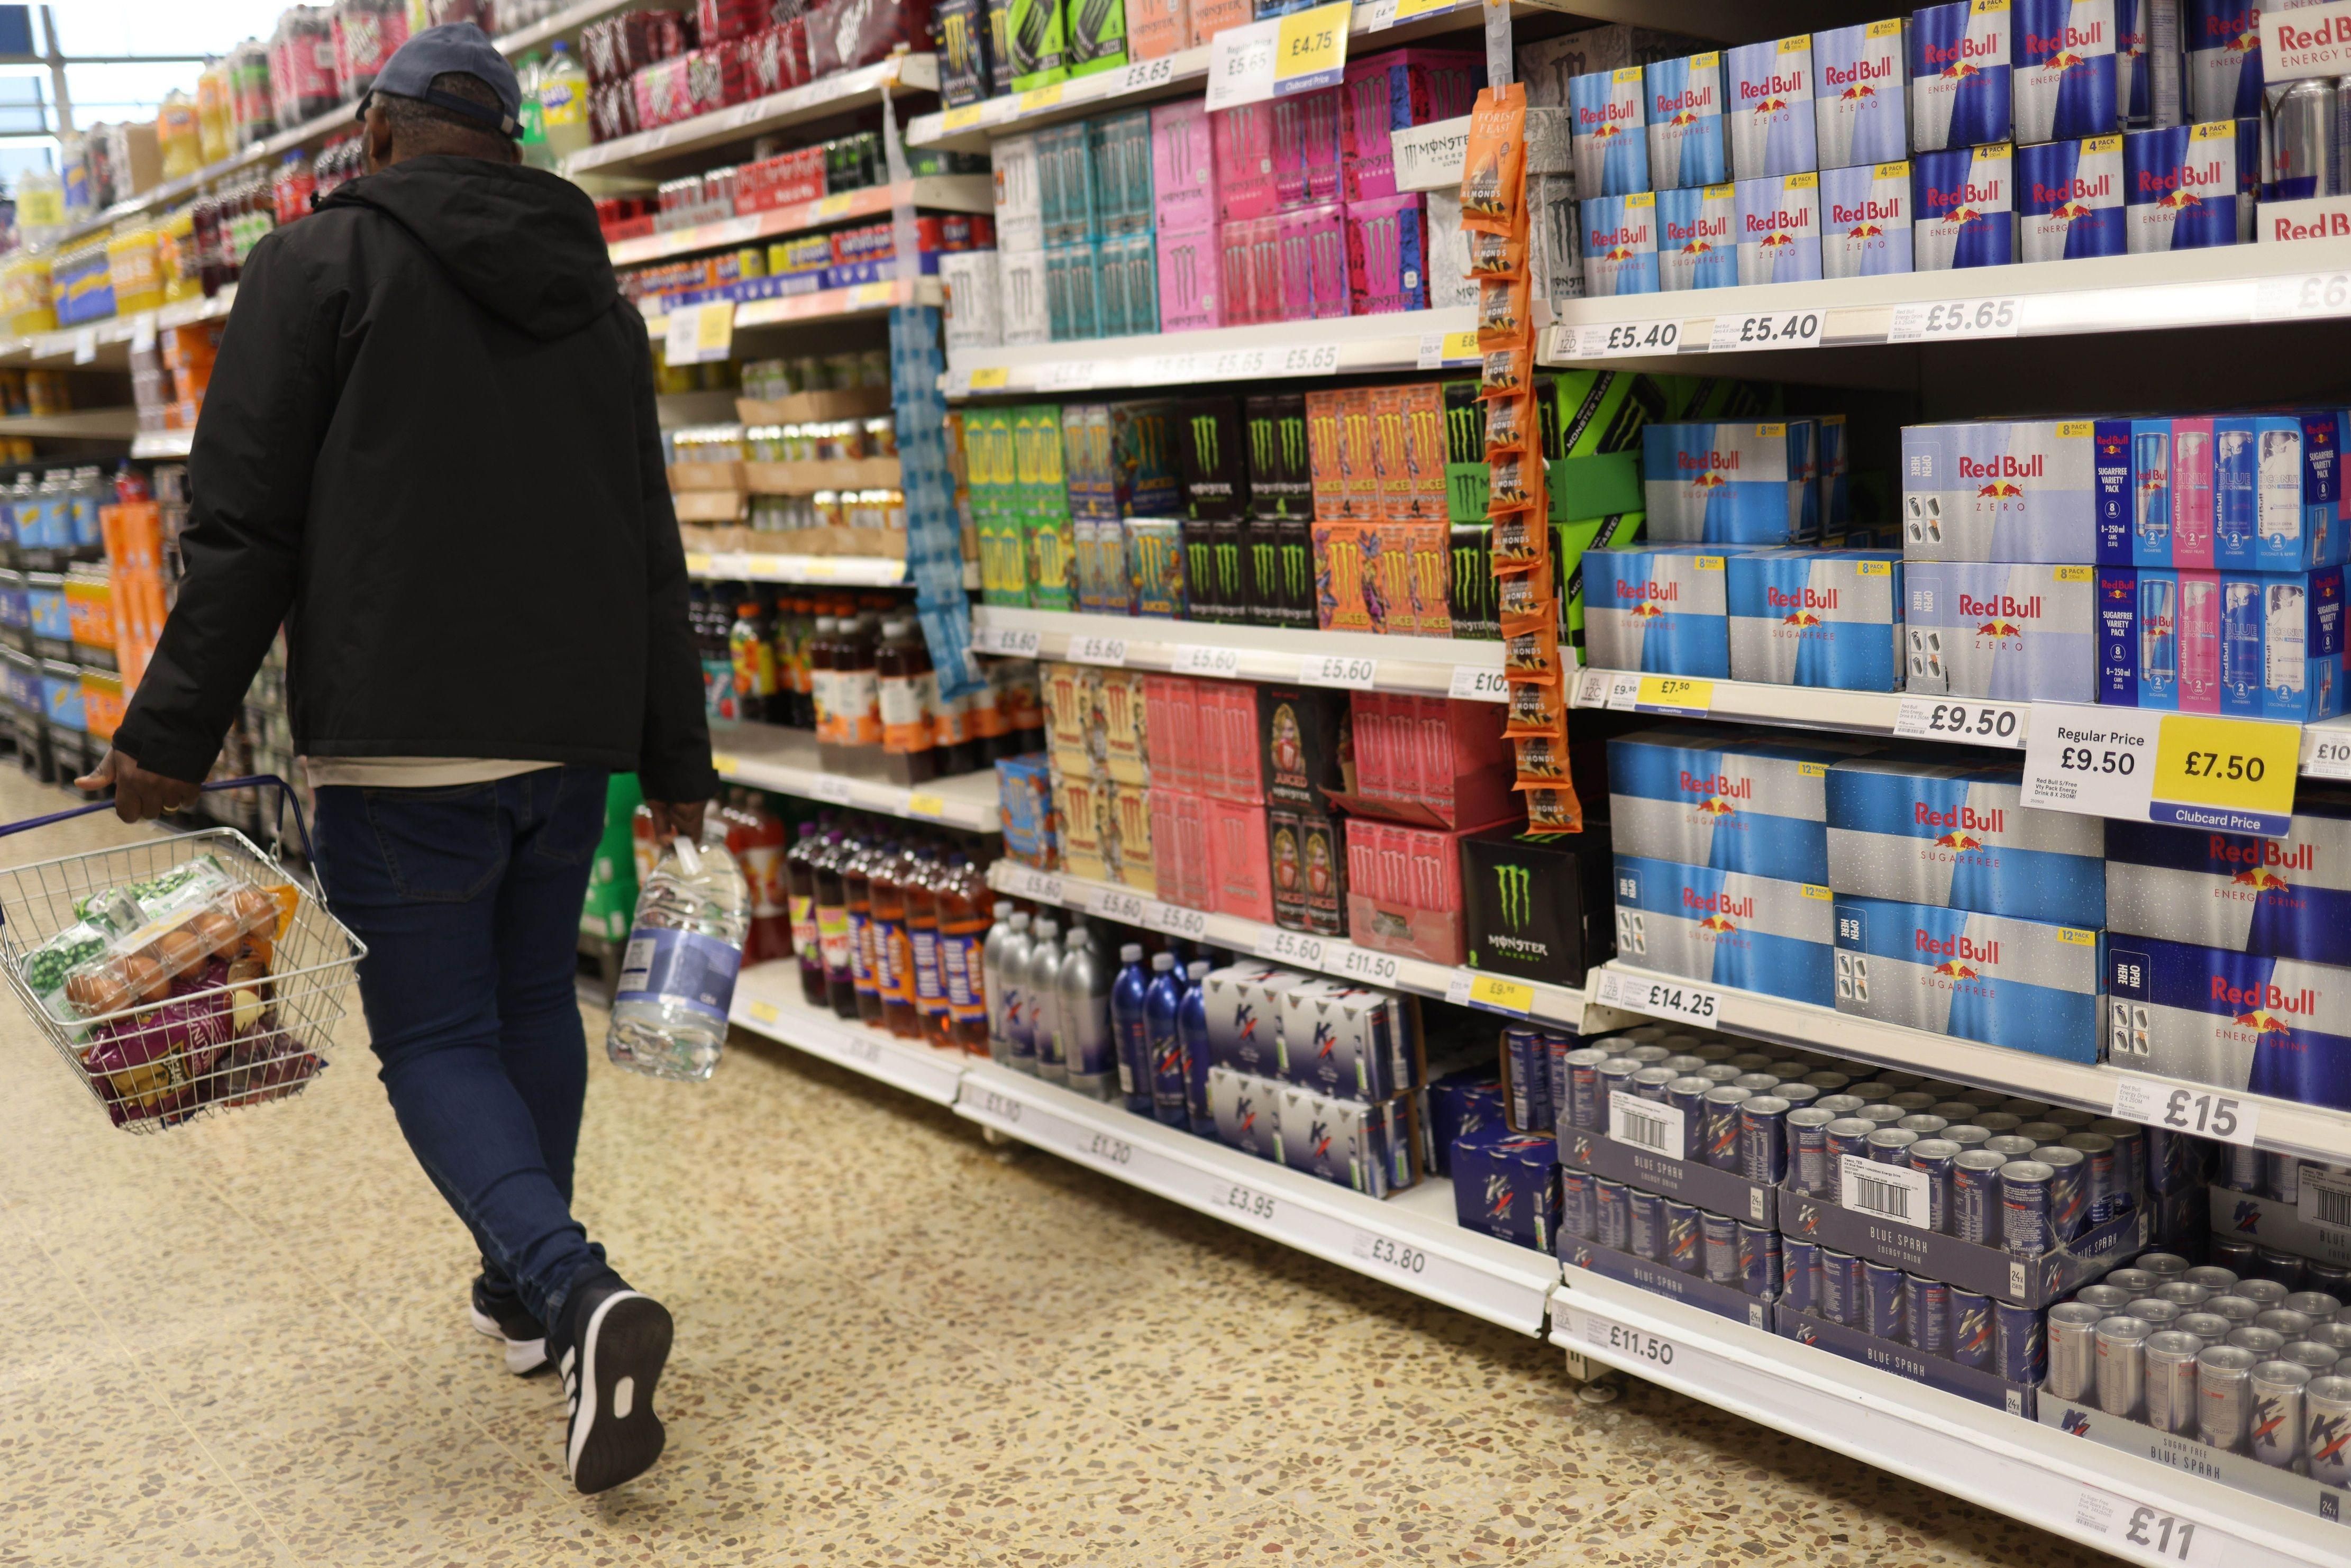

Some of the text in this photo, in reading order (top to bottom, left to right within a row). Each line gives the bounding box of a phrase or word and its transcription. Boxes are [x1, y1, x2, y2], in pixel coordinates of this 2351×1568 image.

[1291, 31, 1332, 56] £4.75
[2026, 21, 2101, 54] Red Bull
[2279, 18, 2331, 51] Red
[1925, 34, 1996, 63] Red Bull
[2282, 50, 2338, 67] ENERGY
[1126, 59, 1171, 87] £5.65
[1826, 57, 1891, 85] Red Bull
[1740, 72, 1801, 99] Red Bull
[1657, 87, 1711, 112] Red Bull
[1839, 101, 1877, 113] ZERO
[1478, 111, 1517, 122] FOREST
[1580, 101, 1634, 125] Red Bull
[1479, 123, 1511, 133] FEAST
[2199, 124, 2226, 138] 4 PACK
[2138, 162, 2220, 191] Red Bull
[1927, 181, 1998, 207] Red Bull
[2032, 175, 2109, 203] Red Bull
[1746, 208, 1808, 231] Red Bull
[1833, 199, 1899, 223] Red Bull
[1592, 225, 1646, 246] Red Bull
[1667, 217, 1726, 239] Red Bull
[2275, 214, 2326, 241] Red
[1846, 240, 1884, 250] ZERO
[1740, 314, 1818, 342] £5.40
[1926, 302, 2014, 331] £5.65
[1608, 324, 1676, 349] £5.40
[1286, 347, 1335, 369] £5.65
[2063, 425, 2070, 436] 8
[2097, 435, 2128, 444] Red Bull
[1678, 451, 1739, 469] Red Bull
[1960, 455, 2042, 478] Red Bull
[2309, 450, 2334, 461] SUGARFREE
[2312, 460, 2331, 469] VARIETY
[2176, 473, 2206, 484] PINK
[2218, 473, 2250, 485] BLUE
[2317, 469, 2328, 478] PACK
[1976, 503, 2025, 512] ZERO
[1495, 535, 1529, 544] ALMONDS
[1617, 580, 1678, 601] Red Bull
[1768, 588, 1837, 609] Red Bull
[1960, 595, 2040, 618] Red Bull
[2103, 612, 2133, 620] SUGARFREE
[1773, 630, 1835, 640] SUGARFREE
[2107, 620, 2128, 628] VARIETY
[2111, 628, 2125, 636] PACK
[1084, 639, 1124, 659] £5.60
[1975, 642, 2022, 651] ZERO
[1192, 649, 1236, 669] £5.60
[1322, 660, 1372, 680] £5.60
[1662, 681, 1689, 694] £7.50
[1929, 705, 2016, 737] £9.50
[2058, 727, 2144, 746] Regular Price
[2061, 747, 2135, 775] £9.50
[2184, 752, 2265, 782] £7.50
[1680, 771, 1751, 798] Red Bull
[1915, 802, 2003, 833] Red Bull
[2176, 810, 2261, 830] Clubcard Price
[1921, 851, 2000, 868] SUGARFREE
[2210, 836, 2312, 871] Red Bull
[1102, 893, 1141, 918] £5.60
[1683, 888, 1753, 918] Red Bull
[1162, 908, 1204, 934] £5.60
[1915, 929, 1999, 964] Red Bull
[2062, 929, 2090, 941] 12 PACK
[1275, 937, 1320, 961] £5.60
[1498, 950, 1540, 962] ENERGY
[1346, 952, 1396, 978] £11.50
[2118, 963, 2128, 984] HERE
[2130, 965, 2140, 988] OPEN
[1921, 977, 1996, 998] SUGARFREE
[2211, 977, 2314, 1015] Red Bull
[1649, 985, 1715, 1017] £14.25
[2120, 1090, 2136, 1098] Energy
[2164, 1090, 2239, 1136] £15
[1092, 1134, 1130, 1164] £1.20
[1635, 1155, 1683, 1179] BLUE SPARK
[1228, 1186, 1274, 1219] £3.95
[1870, 1226, 1928, 1253] BLUE SPARK
[2320, 1230, 2344, 1246] BLUE
[1372, 1239, 1425, 1273] £3.80
[1878, 1245, 1921, 1265] ENERGY DRINK
[1610, 1326, 1673, 1365] £11.50
[1867, 1348, 1925, 1376] BLUE SPARK
[2164, 1438, 2208, 1458] SUGAR FREE
[2150, 1446, 2221, 1480] BLUE SPARK
[2126, 1507, 2195, 1561] £11
